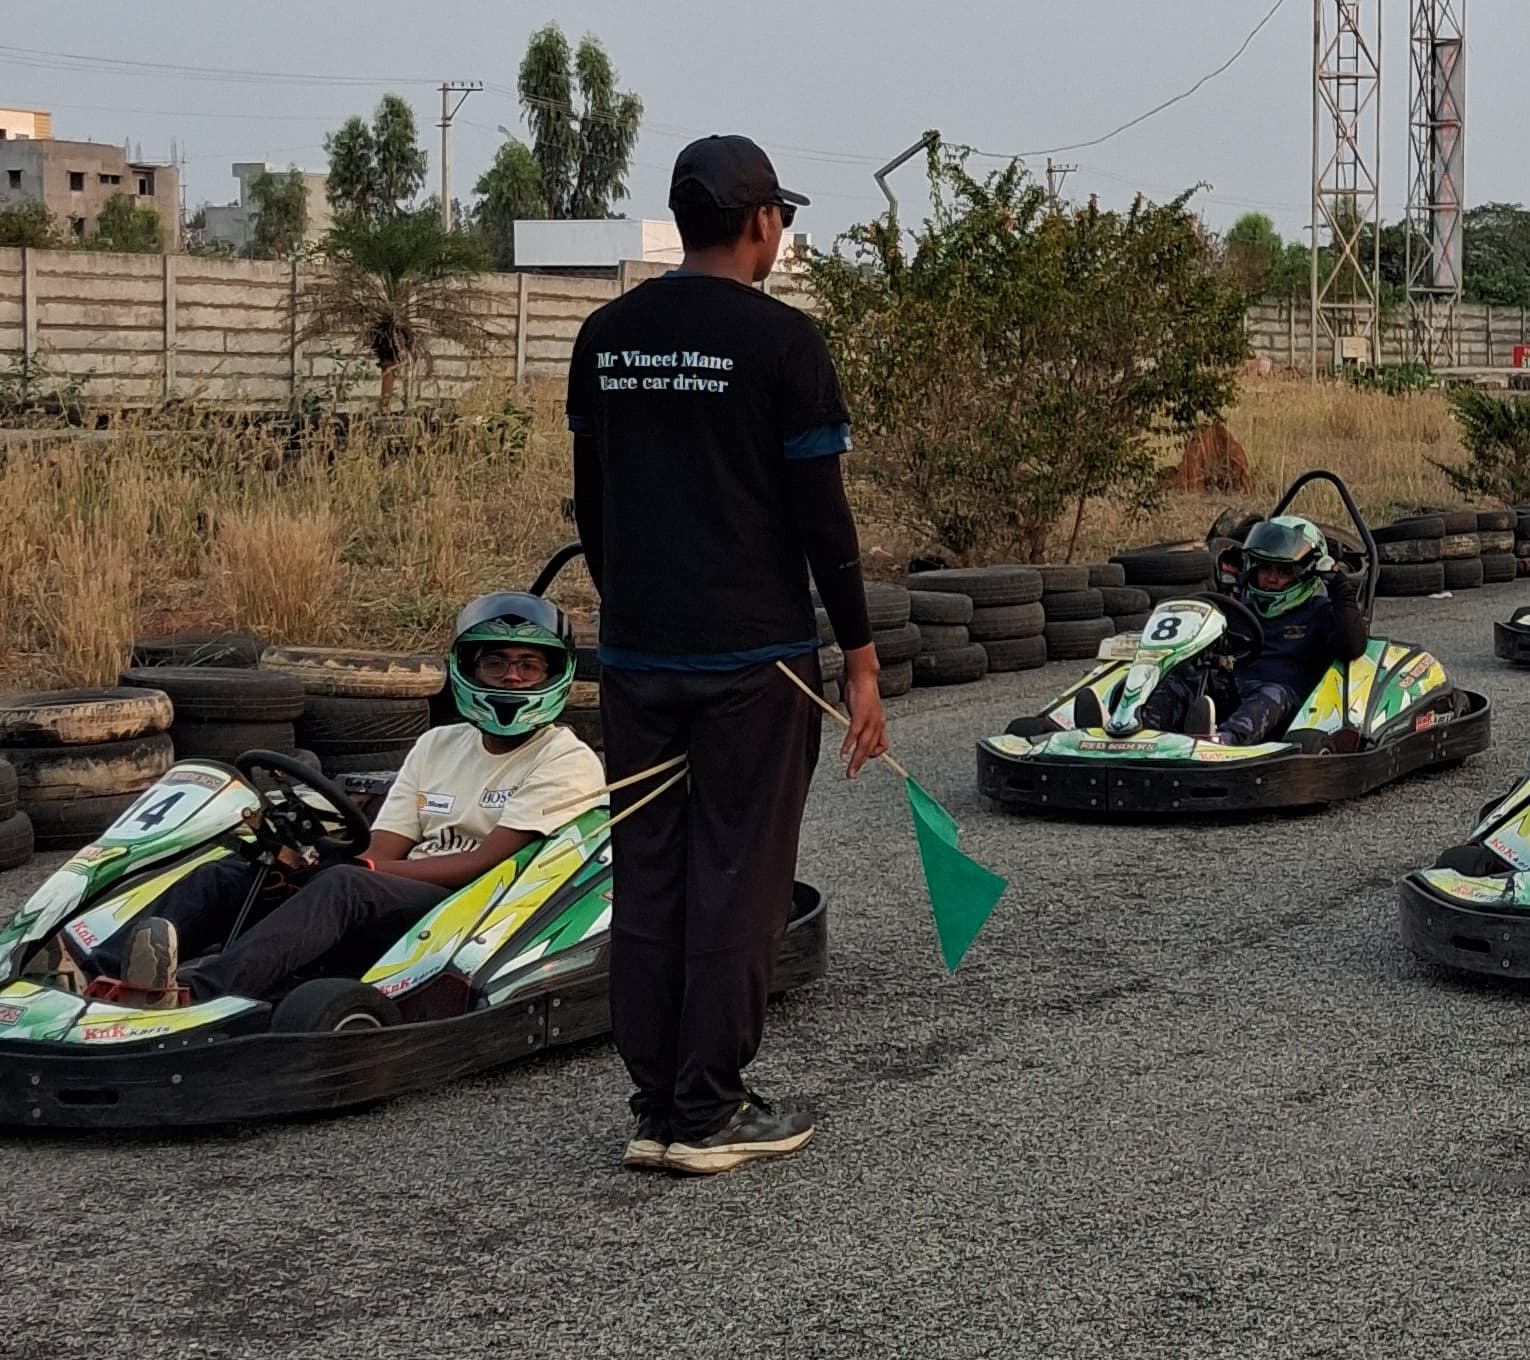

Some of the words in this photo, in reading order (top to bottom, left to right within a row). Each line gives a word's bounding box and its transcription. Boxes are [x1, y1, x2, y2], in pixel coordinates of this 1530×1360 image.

[596, 351, 618, 368] Mr
[681, 351, 734, 371] Mane
[642, 377, 671, 390] car
[673, 374, 729, 393] driver
[1150, 617, 1182, 641] 8
